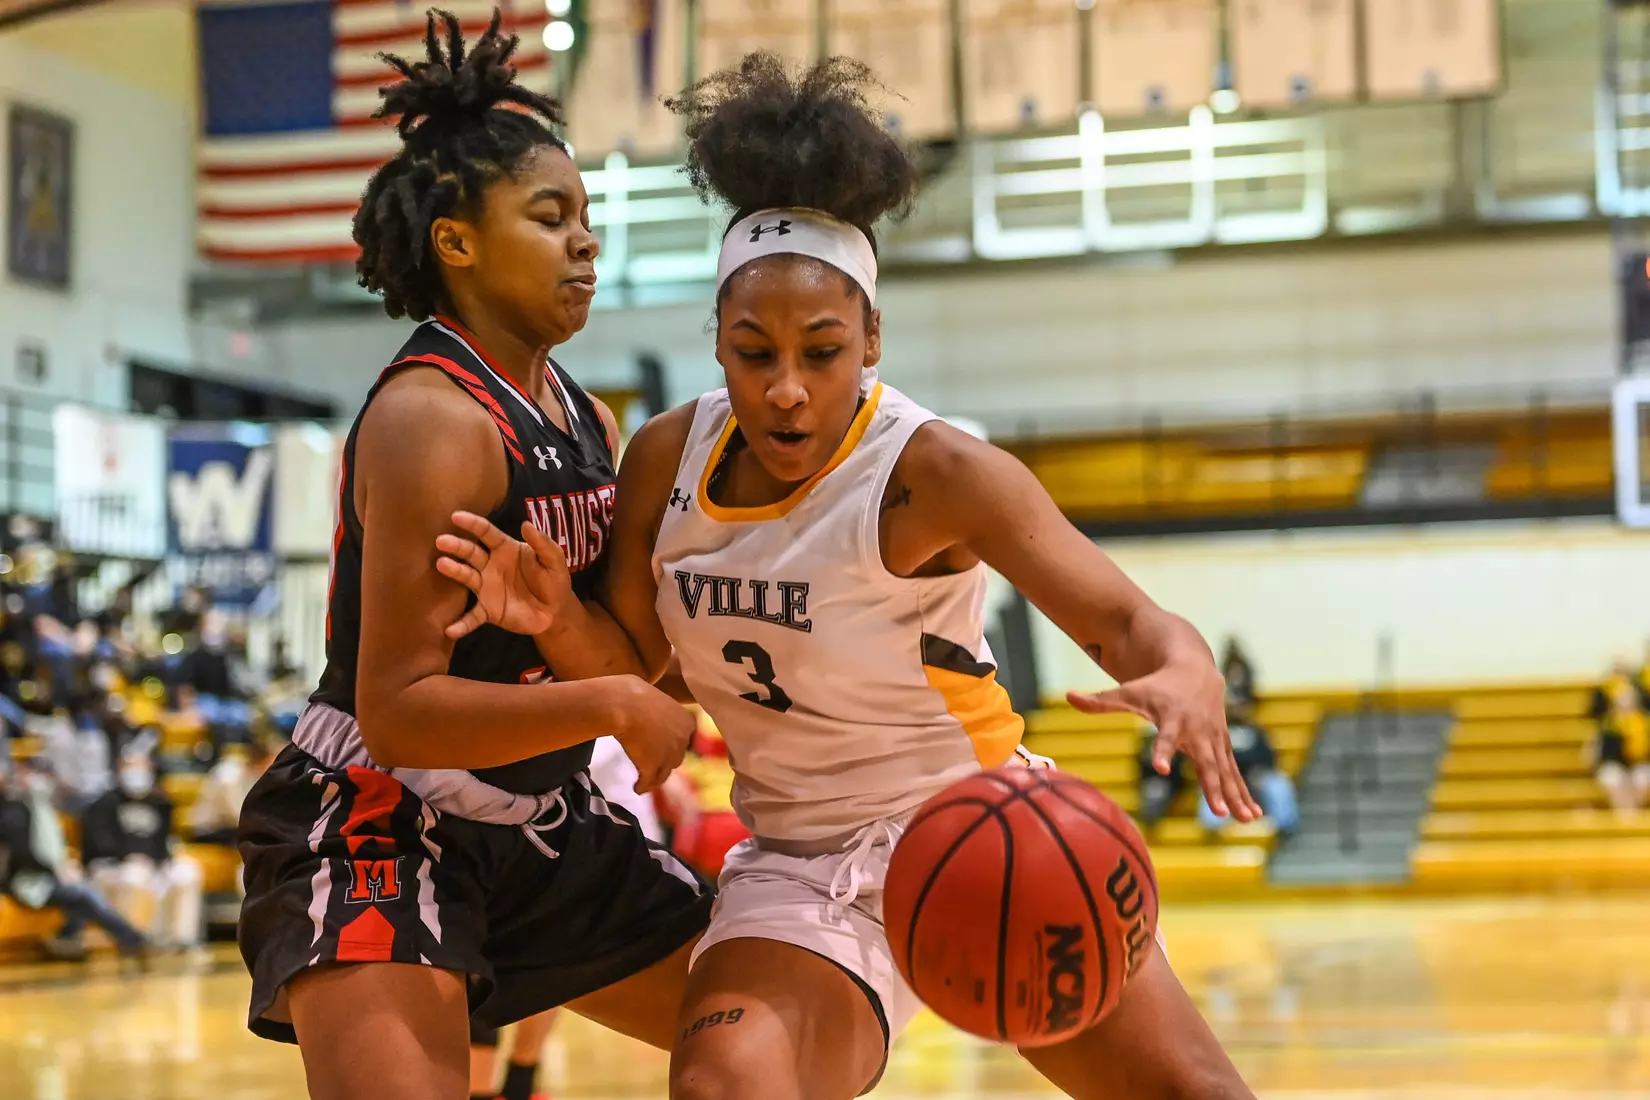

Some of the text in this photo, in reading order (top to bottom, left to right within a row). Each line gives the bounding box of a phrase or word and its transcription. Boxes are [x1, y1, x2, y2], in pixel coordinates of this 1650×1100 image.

[674, 570, 813, 633] VILLE
[721, 639, 793, 714] 3
[344, 856, 406, 904] M
[681, 1007, 745, 1043] 1999
